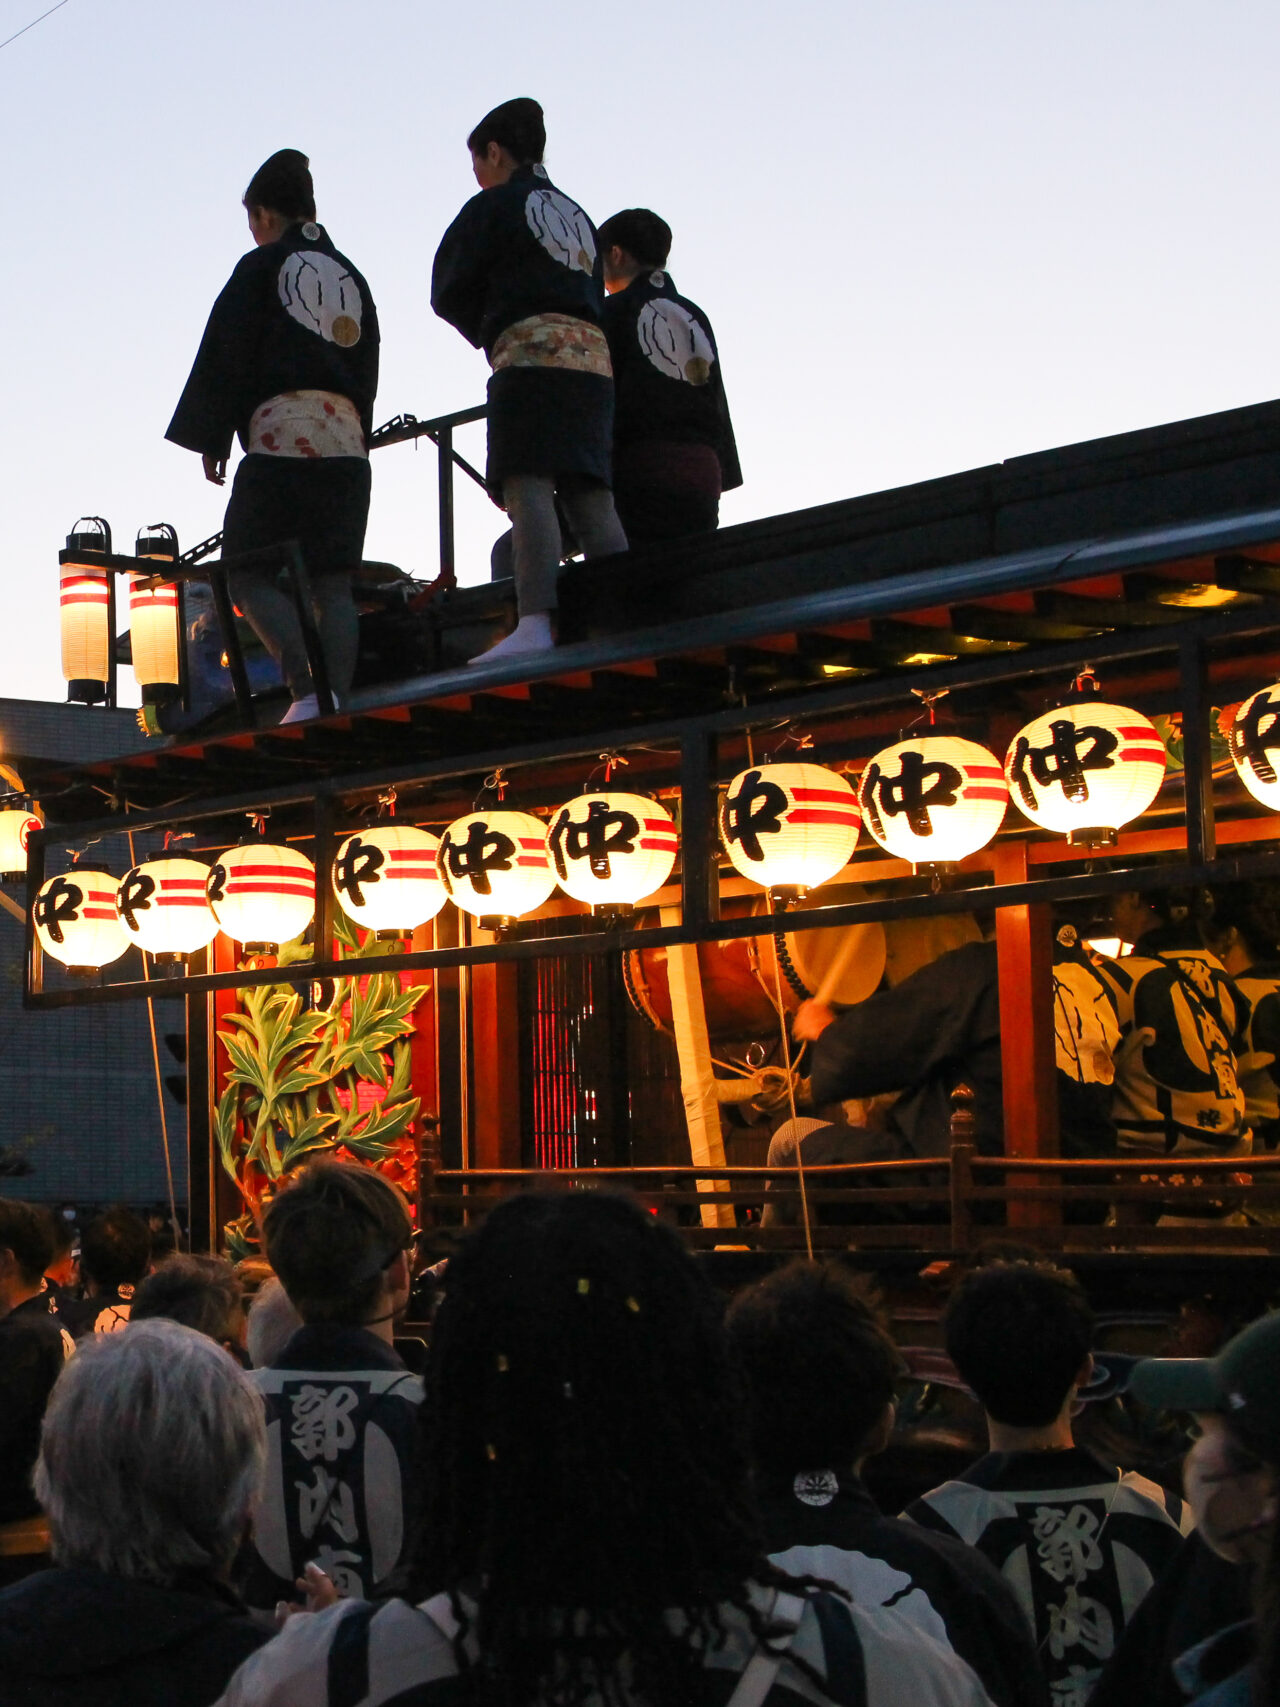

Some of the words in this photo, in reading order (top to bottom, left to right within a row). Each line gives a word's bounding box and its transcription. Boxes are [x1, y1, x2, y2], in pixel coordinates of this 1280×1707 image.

[862, 751, 963, 841] 仲
[1011, 719, 1118, 811] 仲
[437, 822, 516, 895] 仲
[548, 801, 640, 880] 仲
